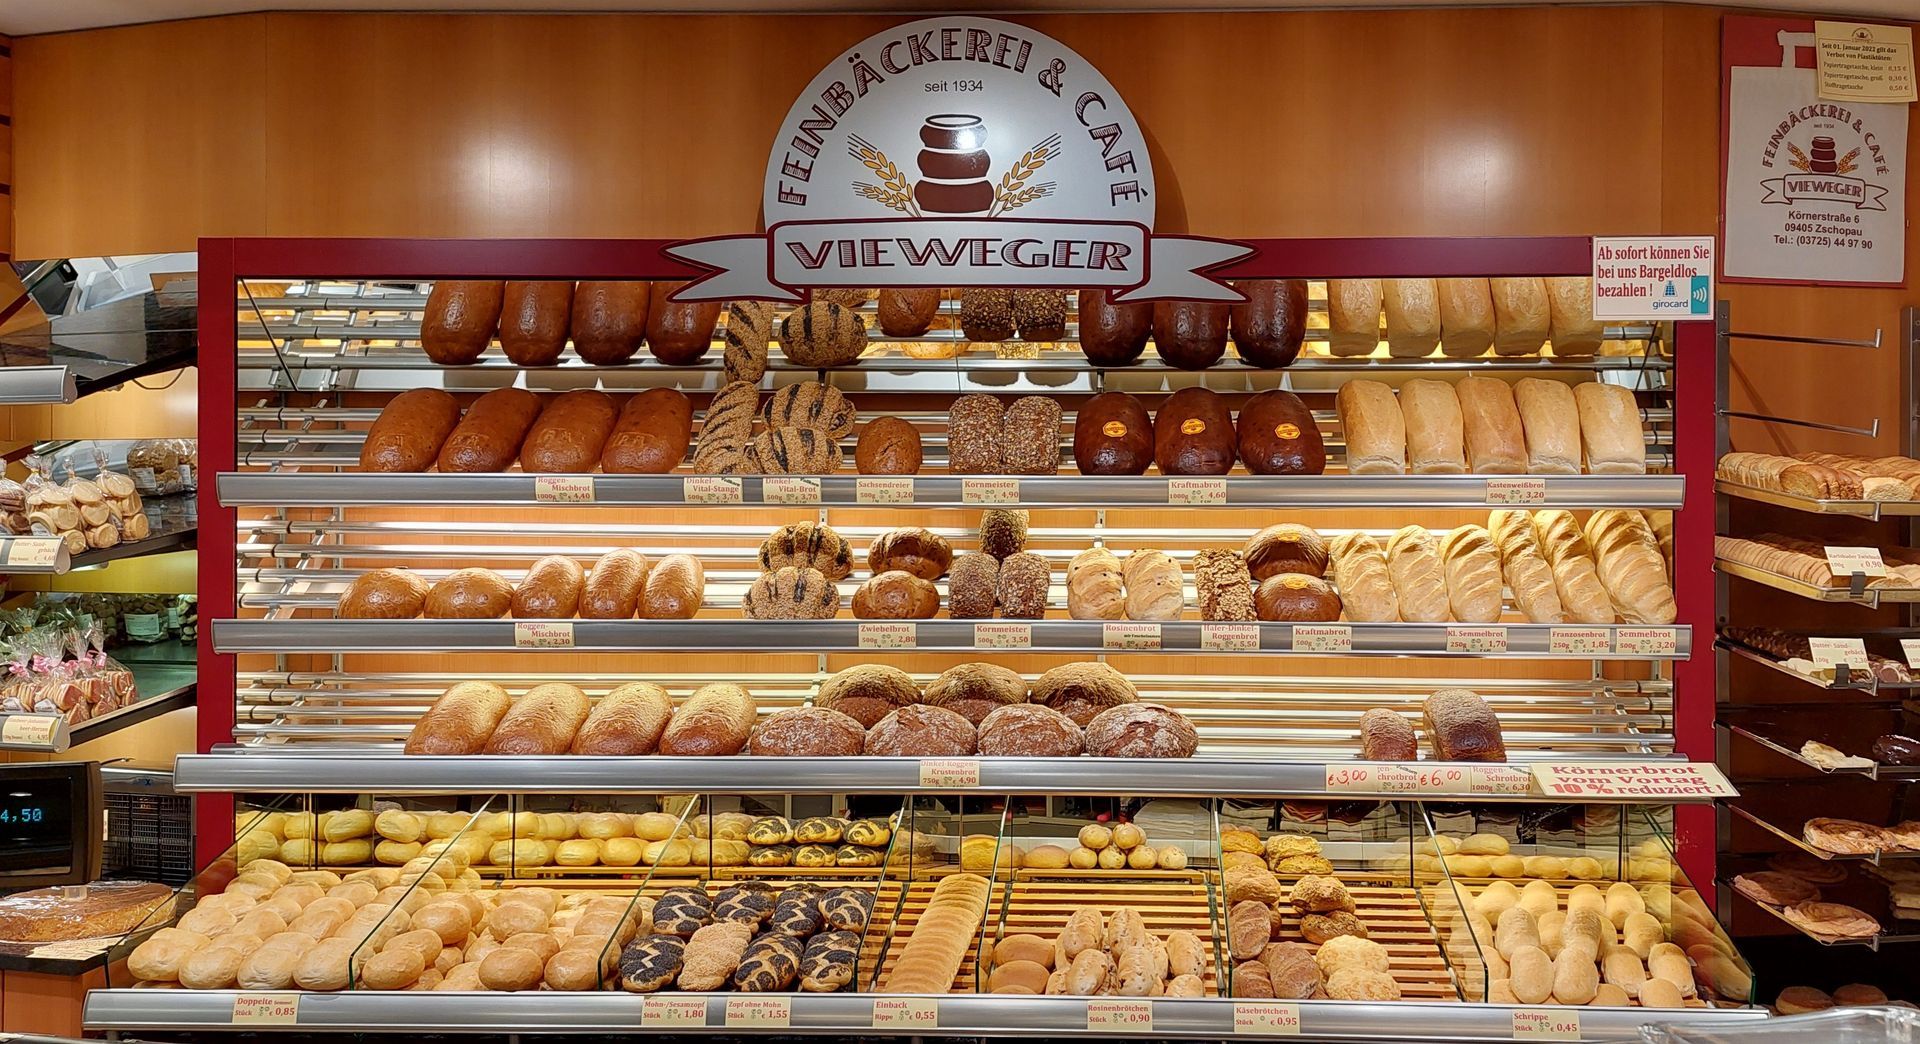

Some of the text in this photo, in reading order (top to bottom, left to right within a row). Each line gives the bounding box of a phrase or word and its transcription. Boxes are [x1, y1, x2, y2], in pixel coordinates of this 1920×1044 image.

[924, 80, 984, 92] seit 1934
[778, 27, 1149, 207] FEINBÄCKEREI & CAFÉ
[1762, 104, 1889, 176] FEINBÄCKEREI & CAFÉ
[1787, 181, 1862, 197] VIEWEGER
[1788, 210, 1860, 223] Körnerstraße 6
[1785, 223, 1863, 237] 09405 Zschopau
[1773, 235, 1873, 249] Tel.: (03725) 44 97 90
[785, 238, 1133, 271] VIEWEGER
[1597, 245, 1709, 260] Ab sofort können Sie
[1598, 264, 1697, 281] bei uns Bargeldlos
[1598, 283, 1653, 297] bezahlen !
[1652, 300, 1688, 310] girocard
[693, 485, 739, 493] Vital-Stange
[896, 491, 913, 499] 3,20
[1002, 491, 1018, 499] 4,90
[1551, 766, 1700, 775] Körnerbrot
[1617, 776, 1708, 786] Vortag
[1550, 784, 1582, 794] 10
[1587, 784, 1614, 794] %
[1618, 785, 1715, 794] reduziert
[1, 809, 41, 822] 4,50
[237, 998, 272, 1006] Doppelte
[275, 1007, 295, 1016] 0,85
[685, 1010, 703, 1018] 1,80
[769, 1010, 787, 1018] 1,55
[915, 1011, 934, 1020] 0,55
[1130, 1014, 1149, 1023] 0,90
[1277, 1017, 1297, 1026] 0,95
[1514, 1013, 1548, 1021] Schrippe
[1557, 1024, 1577, 1032] 0,45
